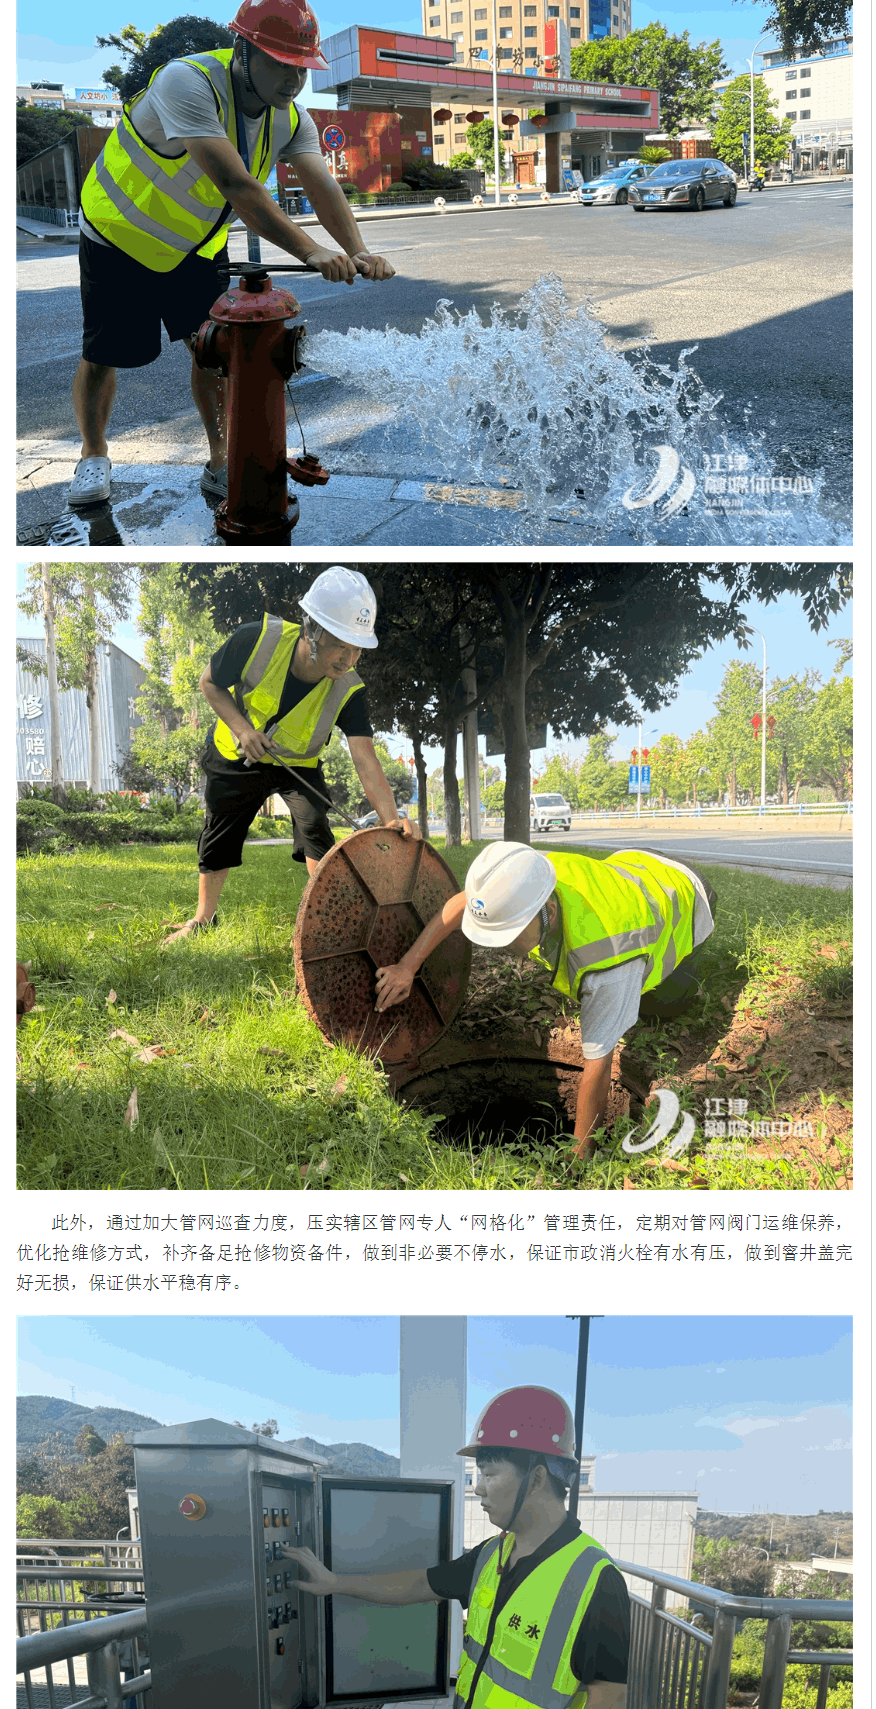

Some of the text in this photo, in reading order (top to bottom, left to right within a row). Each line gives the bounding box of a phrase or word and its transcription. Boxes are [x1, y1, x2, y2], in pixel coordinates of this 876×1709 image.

[532, 80, 555, 92] JIANGJIN
[583, 86, 603, 96] PRIMARY
[604, 89, 622, 97] SCHOOL
[19, 694, 44, 720] 修
[25, 737, 45, 756] 赔
[25, 758, 45, 776] 心
[16, 1273, 239, 1292] 好无损，保证供水平稳有序。
[507, 1613, 541, 1640] 供水
